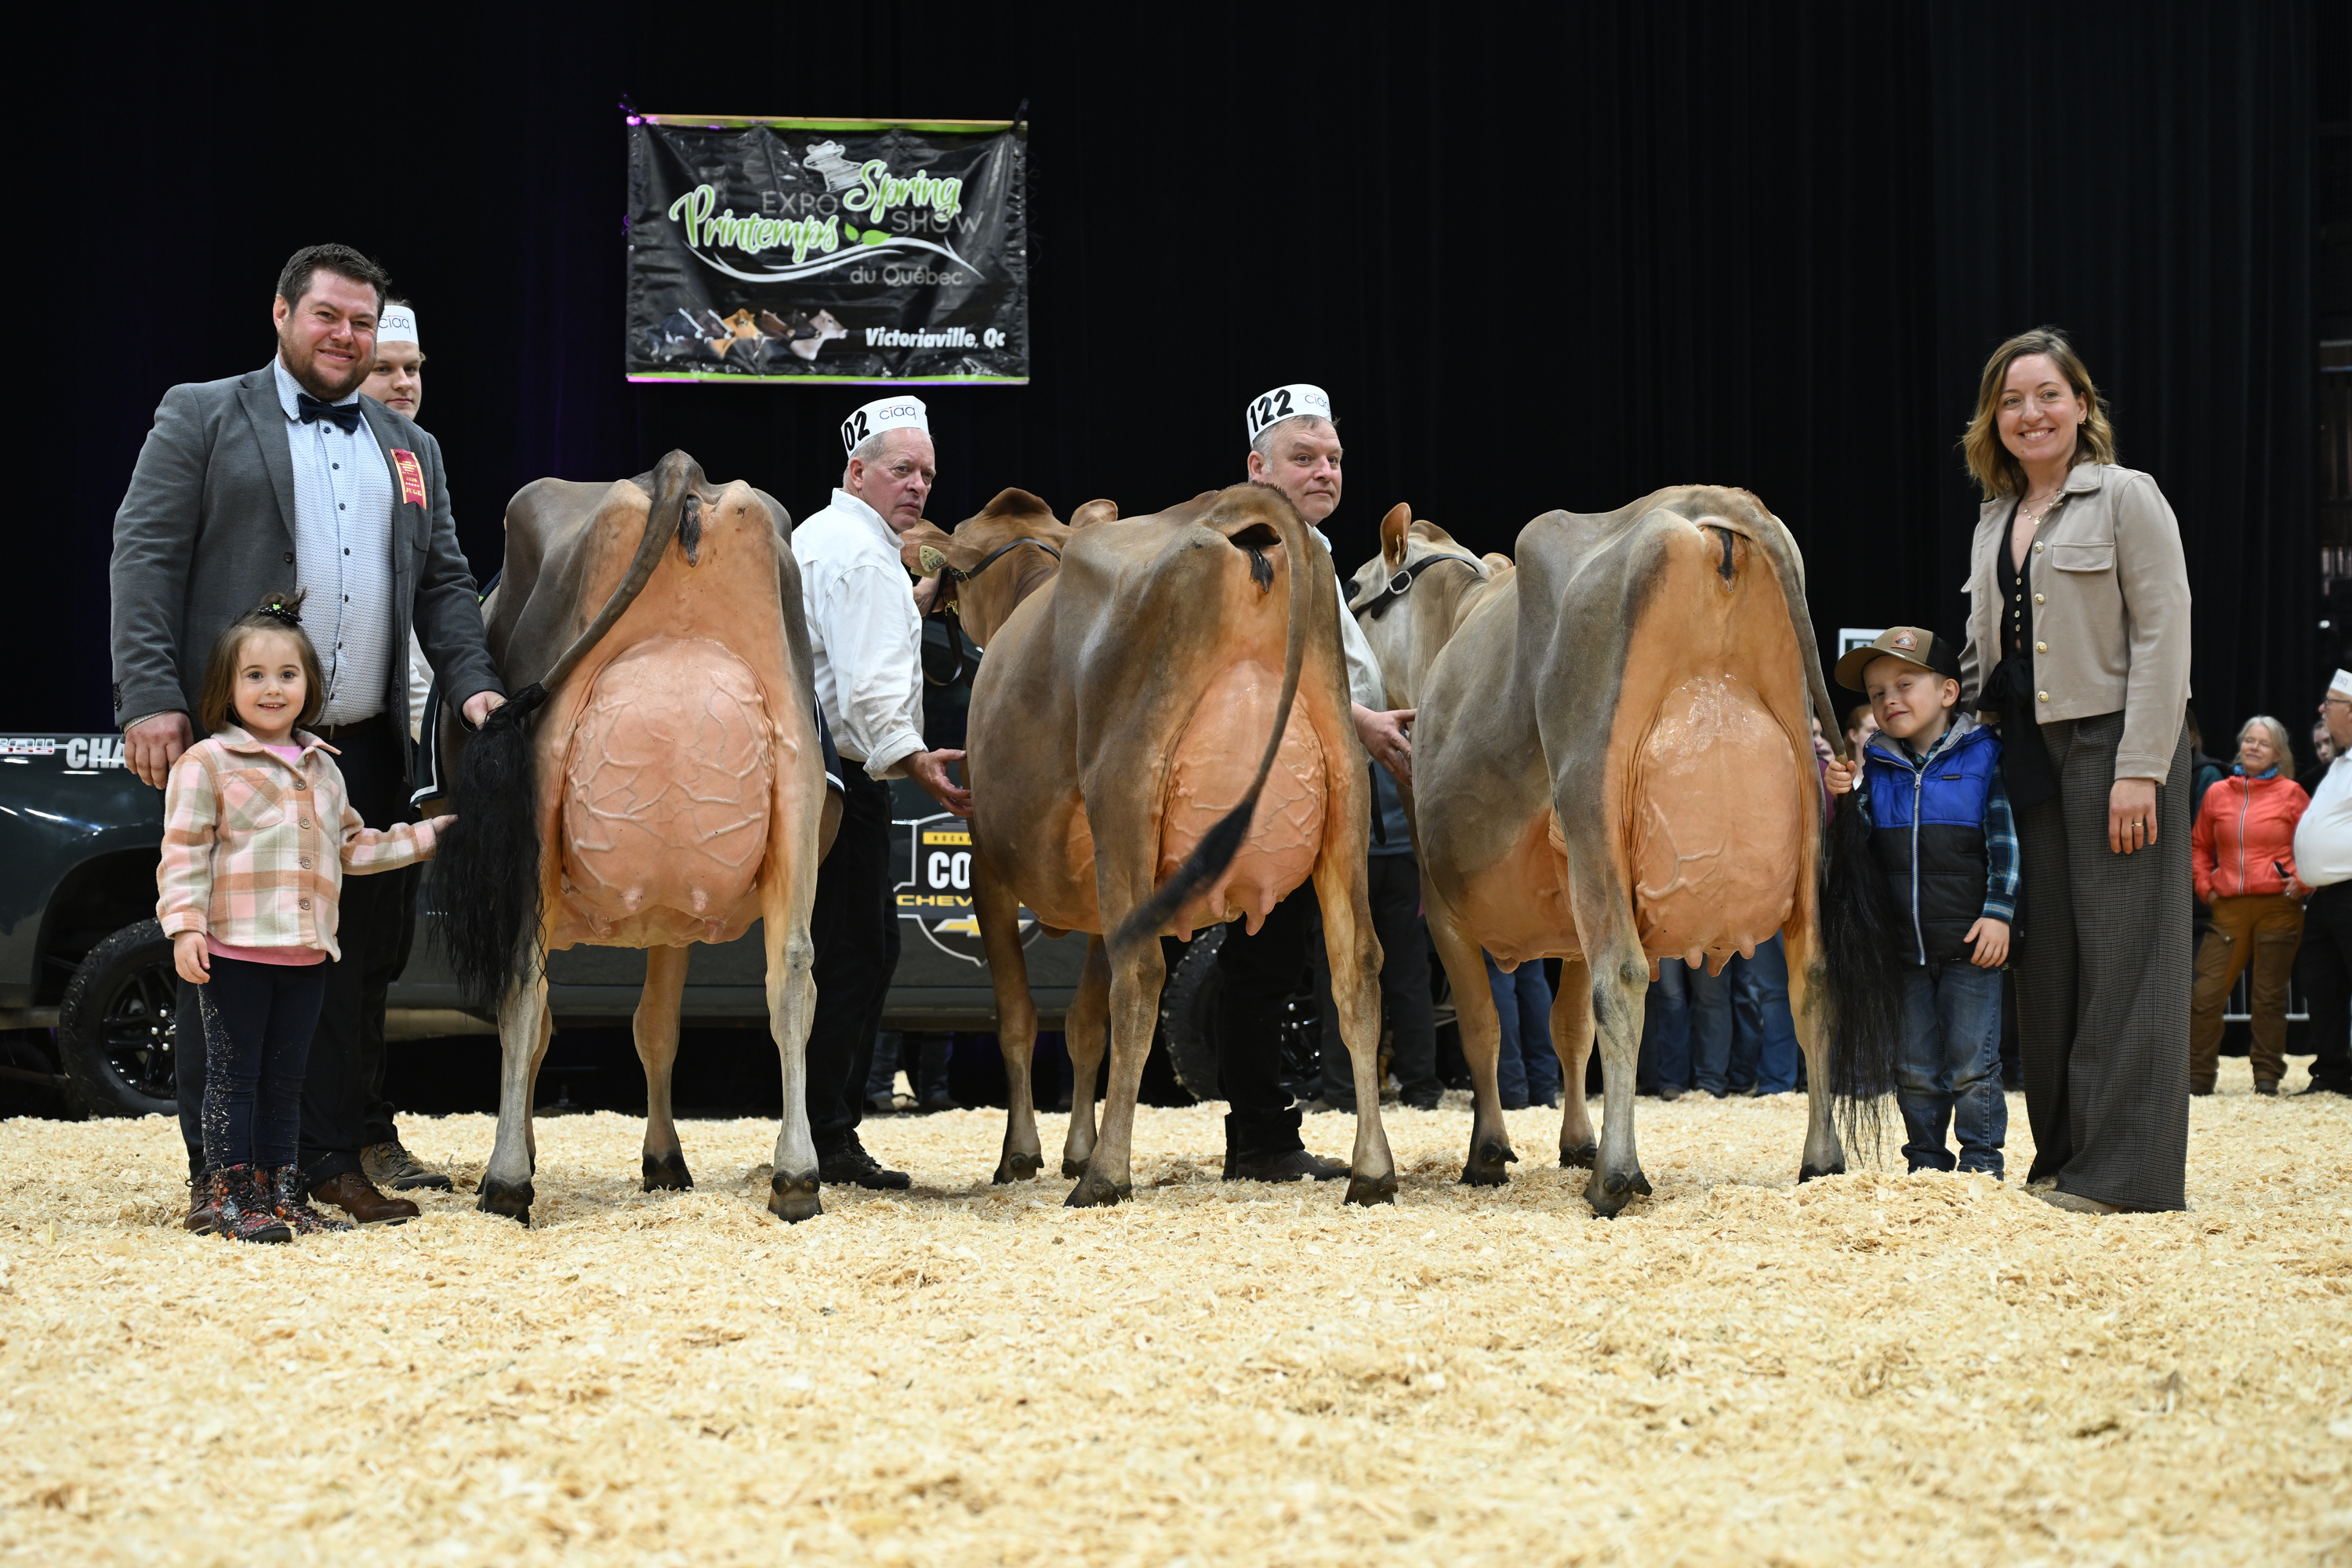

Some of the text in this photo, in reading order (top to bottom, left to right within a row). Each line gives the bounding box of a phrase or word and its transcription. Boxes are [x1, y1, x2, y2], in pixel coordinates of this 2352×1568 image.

[761, 191, 839, 215] EXPO
[843, 159, 962, 223] Spring
[669, 184, 840, 263] Printemps
[891, 209, 984, 234] SHOW
[850, 265, 964, 287] du Québec
[379, 315, 412, 334] ciaq
[865, 326, 1007, 349] Victoriaville, Qc
[879, 406, 917, 420] ciaq
[1250, 389, 1294, 433] 122
[405, 487, 423, 496] JUGE
[66, 737, 129, 769] CHA
[927, 851, 973, 890] CO
[896, 894, 974, 907] CHEV
